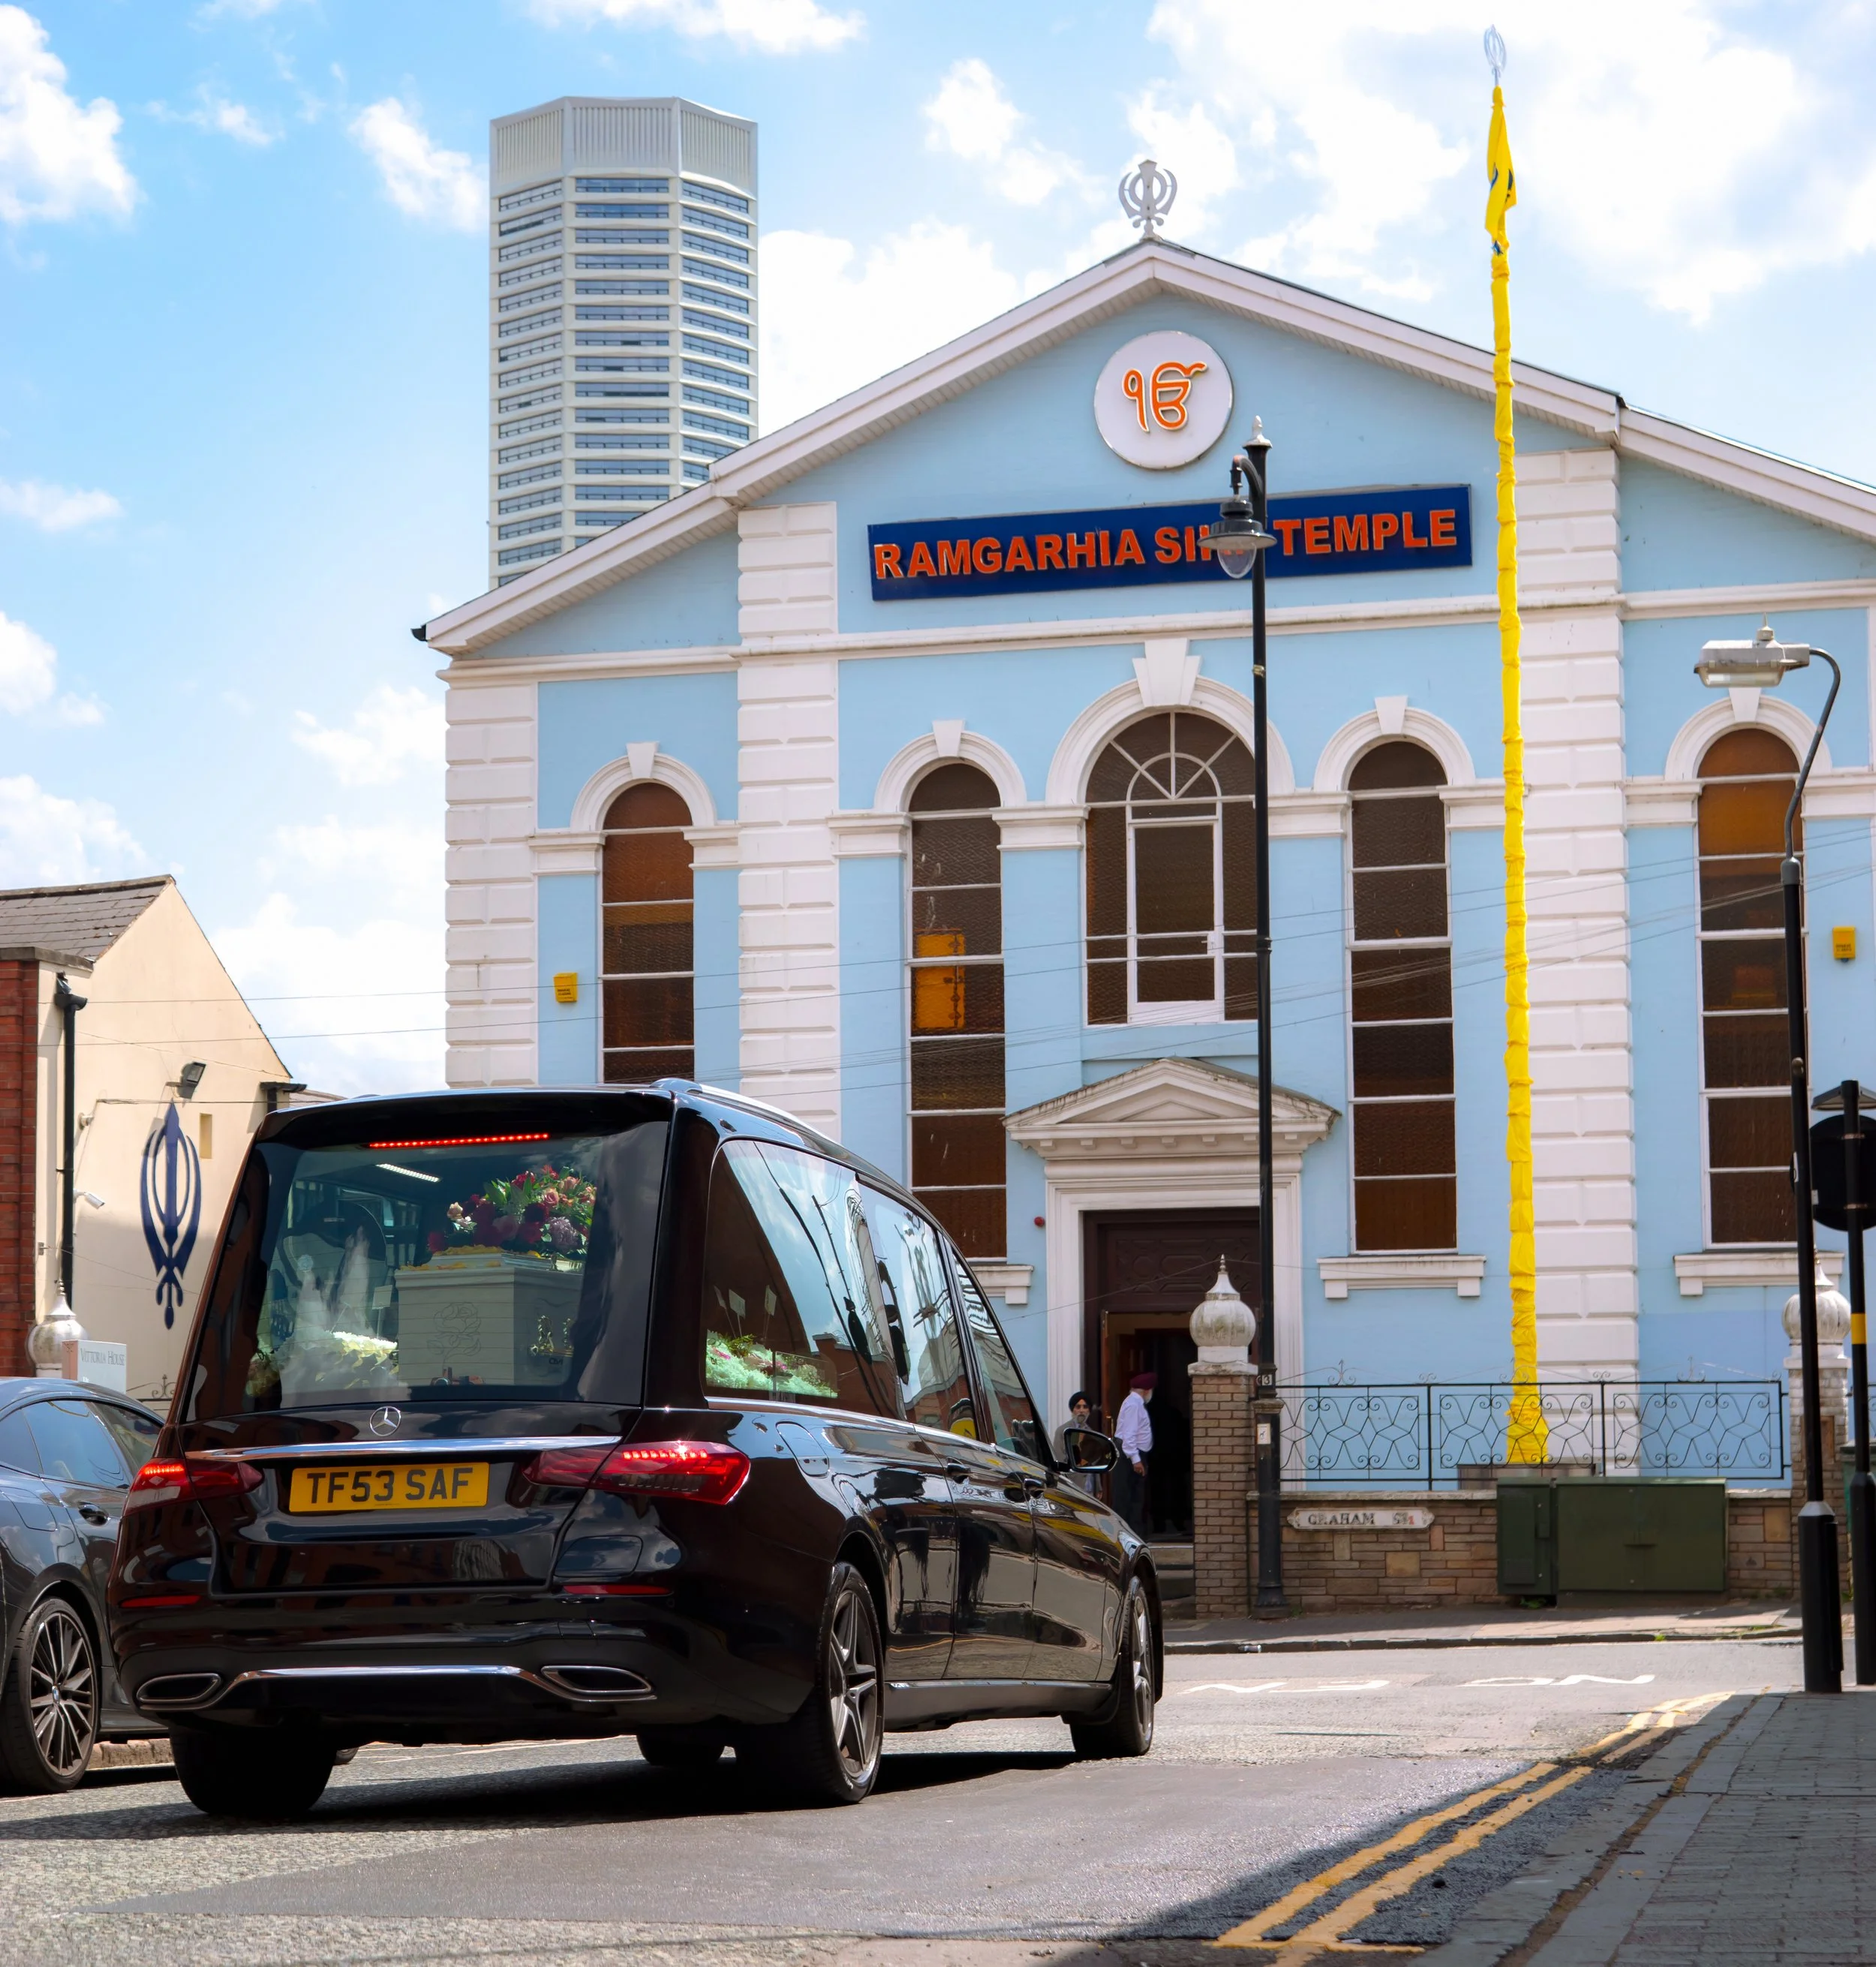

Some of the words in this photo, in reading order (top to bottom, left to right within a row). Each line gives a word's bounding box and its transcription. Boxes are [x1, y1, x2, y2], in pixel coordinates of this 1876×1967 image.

[876, 528, 1146, 580] RAMGARHIA
[1154, 524, 1246, 564] SI
[1273, 508, 1457, 556] TEMPLE
[107, 1350, 125, 1366] HOUSE
[306, 1469, 395, 1504] TF53
[405, 1467, 473, 1500] SAF
[1308, 1511, 1375, 1525] GRAHAM
